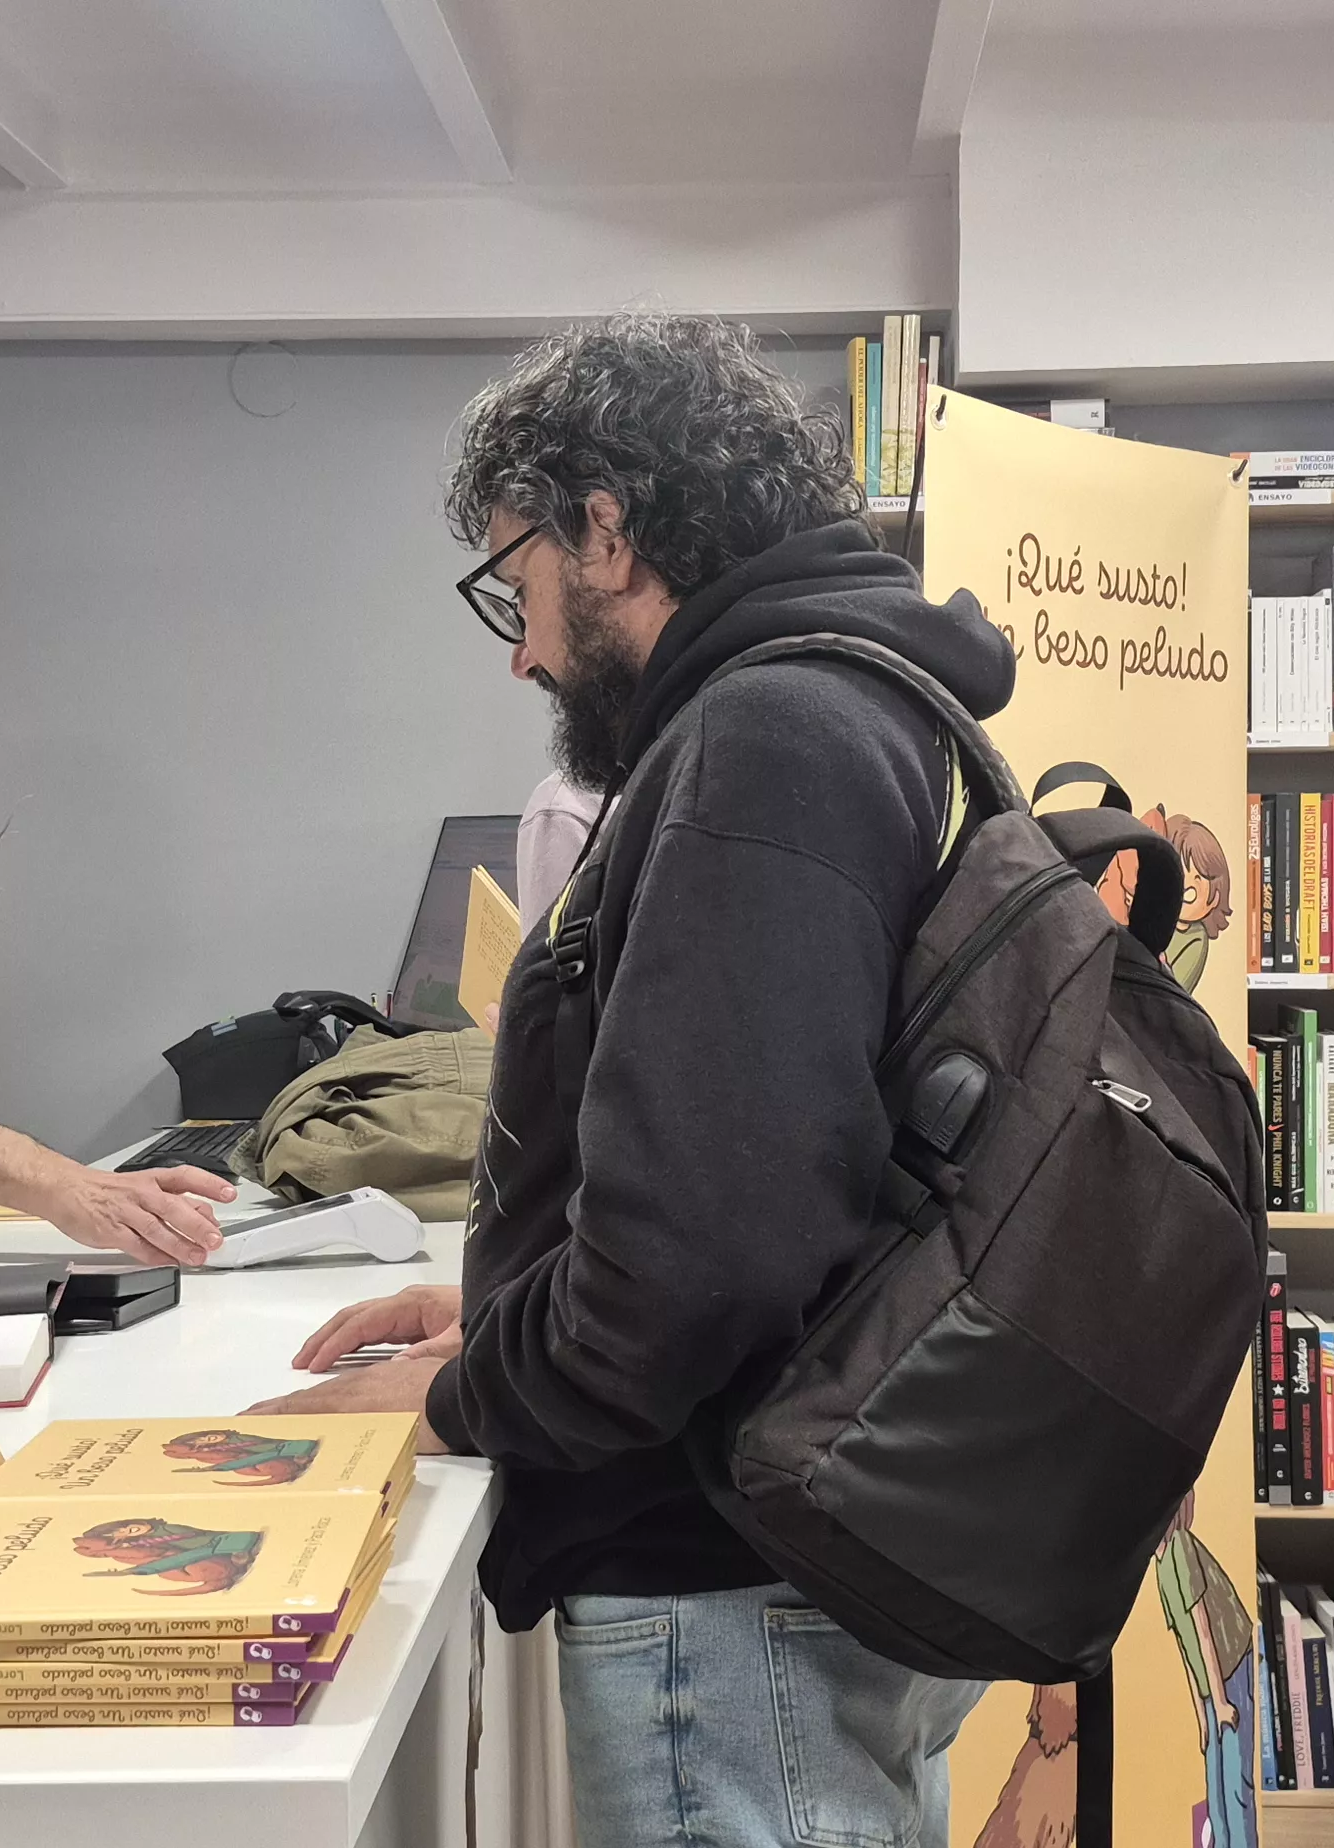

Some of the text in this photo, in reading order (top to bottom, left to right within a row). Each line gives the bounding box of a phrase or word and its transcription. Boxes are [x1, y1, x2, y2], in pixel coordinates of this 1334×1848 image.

[872, 499, 906, 508] ENSAYO
[1258, 493, 1293, 501] ENSAYO
[1006, 532, 1187, 612] ¡Qué susto!
[1034, 609, 1108, 670] beso
[1120, 625, 1229, 691] peludo
[1272, 1050, 1283, 1123] NUNCA TE PARES
[1272, 1131, 1282, 1188] PHIL KNIGHT
[35, 1438, 101, 1480] ¡Qué susto!
[59, 1428, 144, 1490] Un beso peludo
[3, 1516, 53, 1552] peludo
[41, 1616, 249, 1635] ¡Qué susto! Un beso peludo
[17, 1642, 220, 1658] ¡Qué susto! Un beso peludo
[5, 1682, 209, 1700] ¡Qué susto! Un beso peludo
[42, 1664, 249, 1682] ¡Qué susto! Un beso peludo
[7, 1705, 211, 1722] ¡Qué susto! Un beso peludo
[1291, 1691, 1306, 1767] LOVE, FREDDIE
